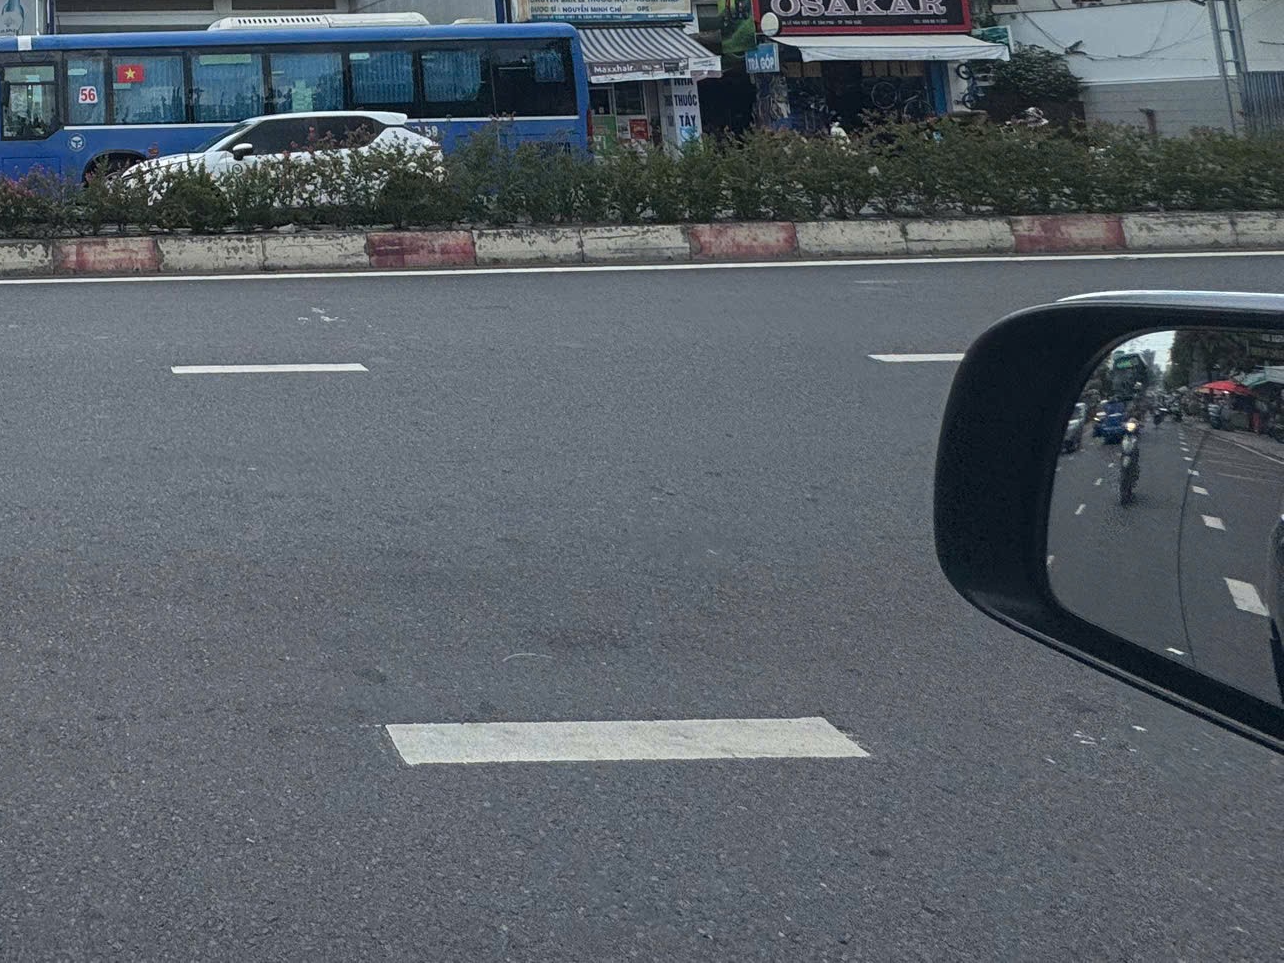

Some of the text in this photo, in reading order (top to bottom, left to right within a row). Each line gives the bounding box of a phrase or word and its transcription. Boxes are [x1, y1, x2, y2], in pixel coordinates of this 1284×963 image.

[562, 4, 589, 13] NGUYỄN
[590, 5, 608, 13] MINH
[759, 54, 775, 70] GÓP
[80, 88, 96, 102] 56
[674, 92, 698, 107] THUỐC
[678, 114, 697, 126] TÂY
